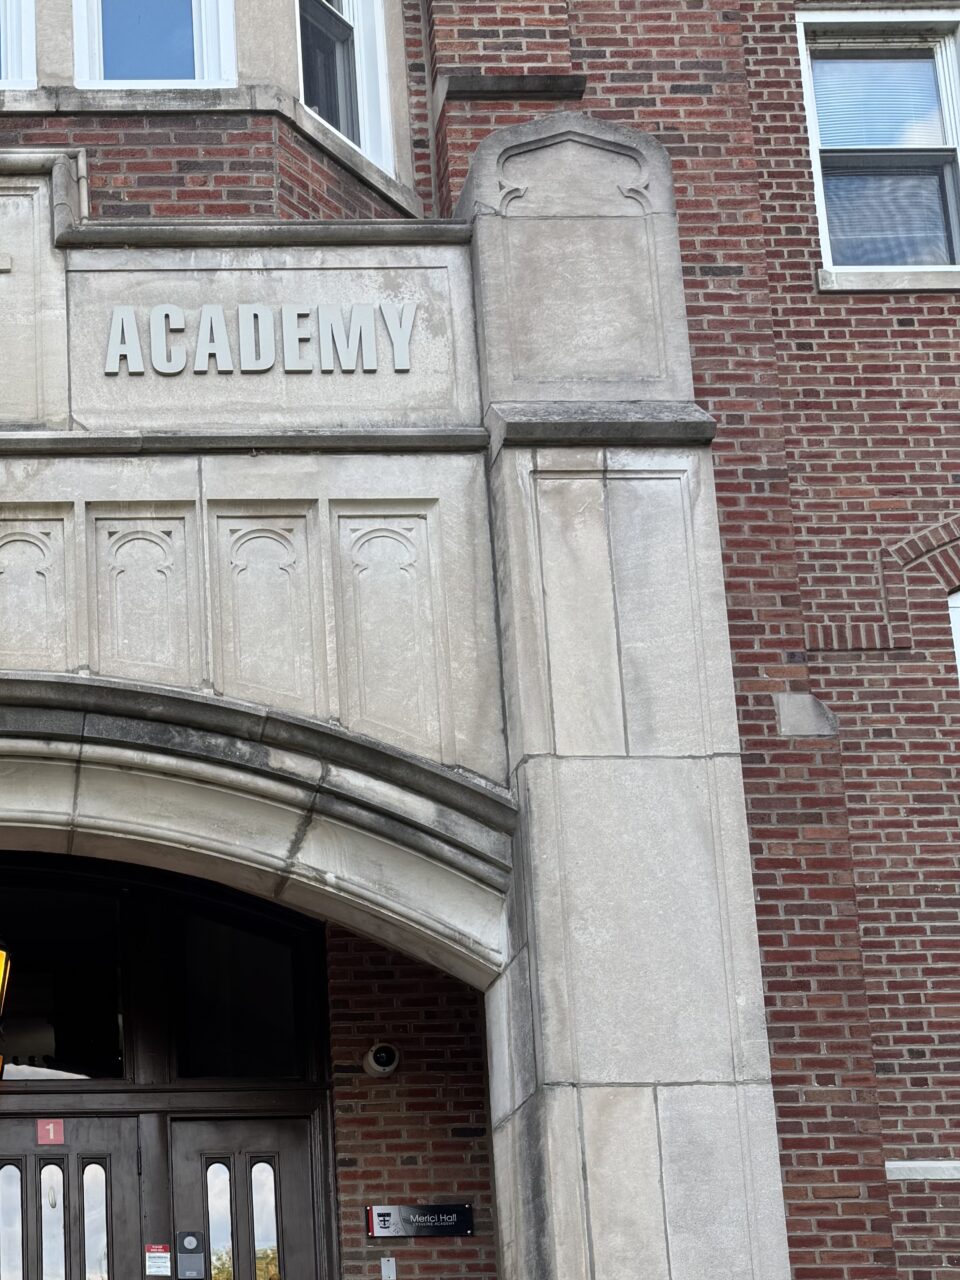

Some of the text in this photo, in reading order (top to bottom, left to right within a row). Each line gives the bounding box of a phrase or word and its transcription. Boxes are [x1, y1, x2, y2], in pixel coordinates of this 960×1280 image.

[104, 303, 417, 377] ACADEMY
[45, 1123, 55, 1140] 1
[410, 1213, 457, 1222] Merici Hall
